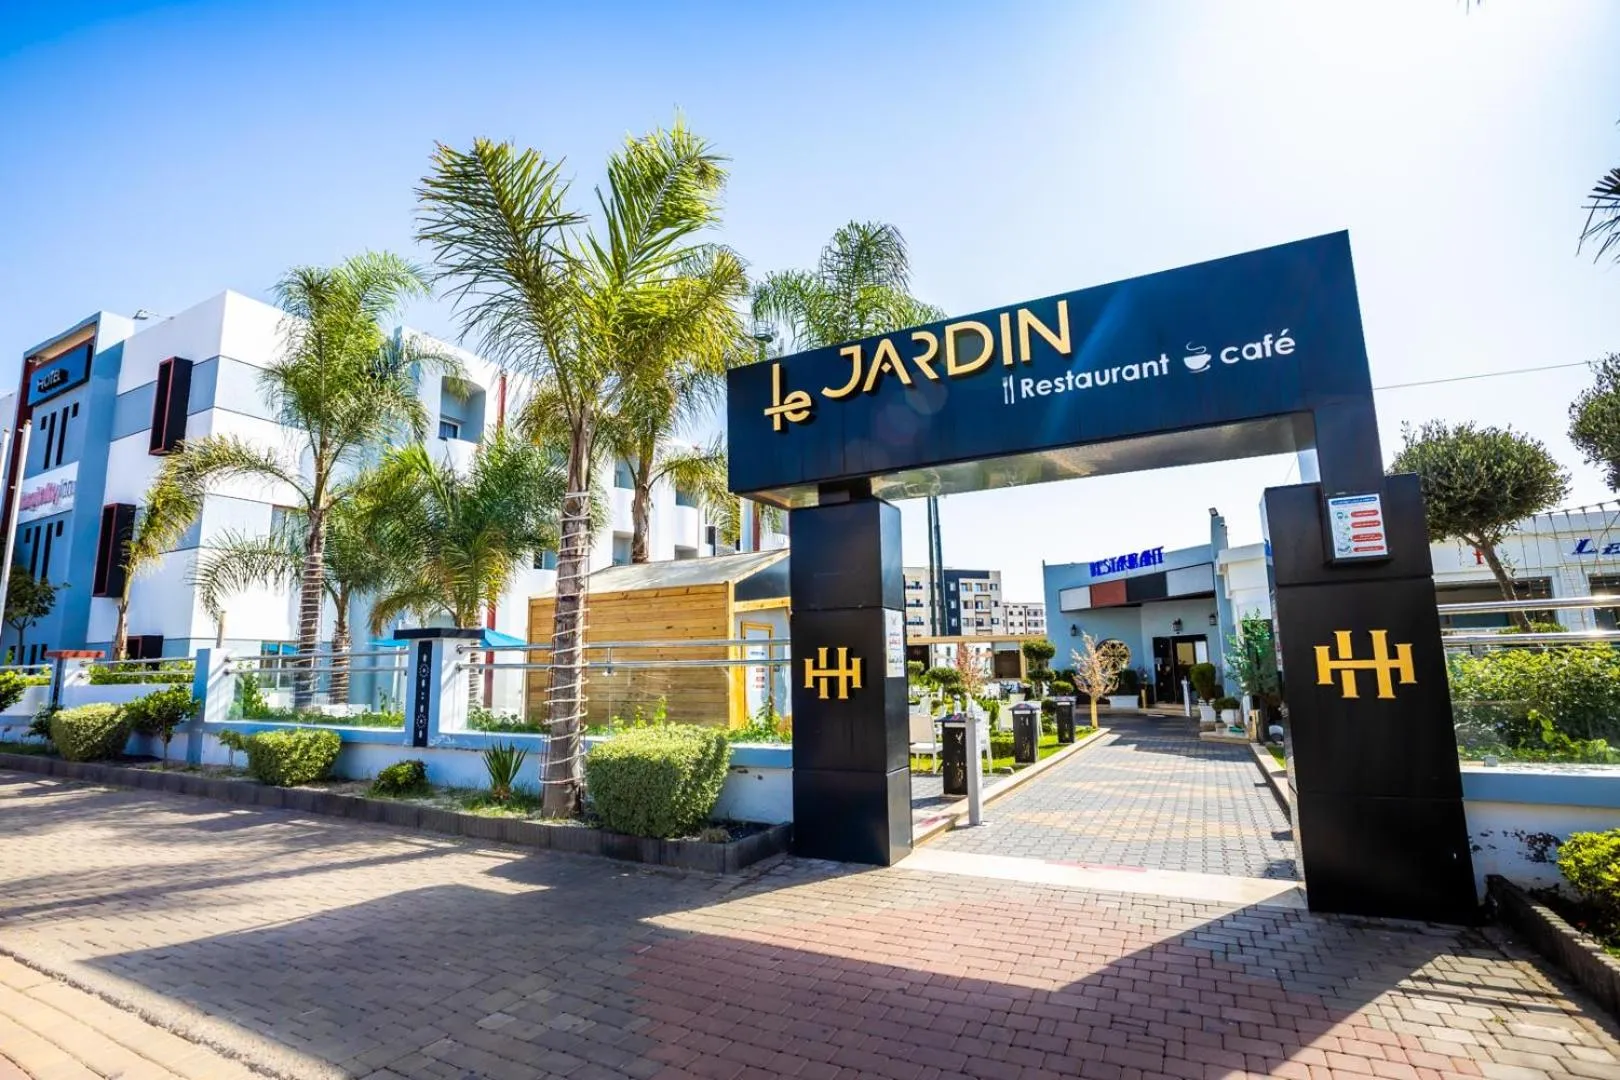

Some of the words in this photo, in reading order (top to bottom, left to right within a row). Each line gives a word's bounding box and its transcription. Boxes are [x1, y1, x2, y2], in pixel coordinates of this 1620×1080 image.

[821, 299, 1072, 399] JARDIN
[1020, 352, 1170, 399] Restaurant
[1220, 328, 1296, 366] café
